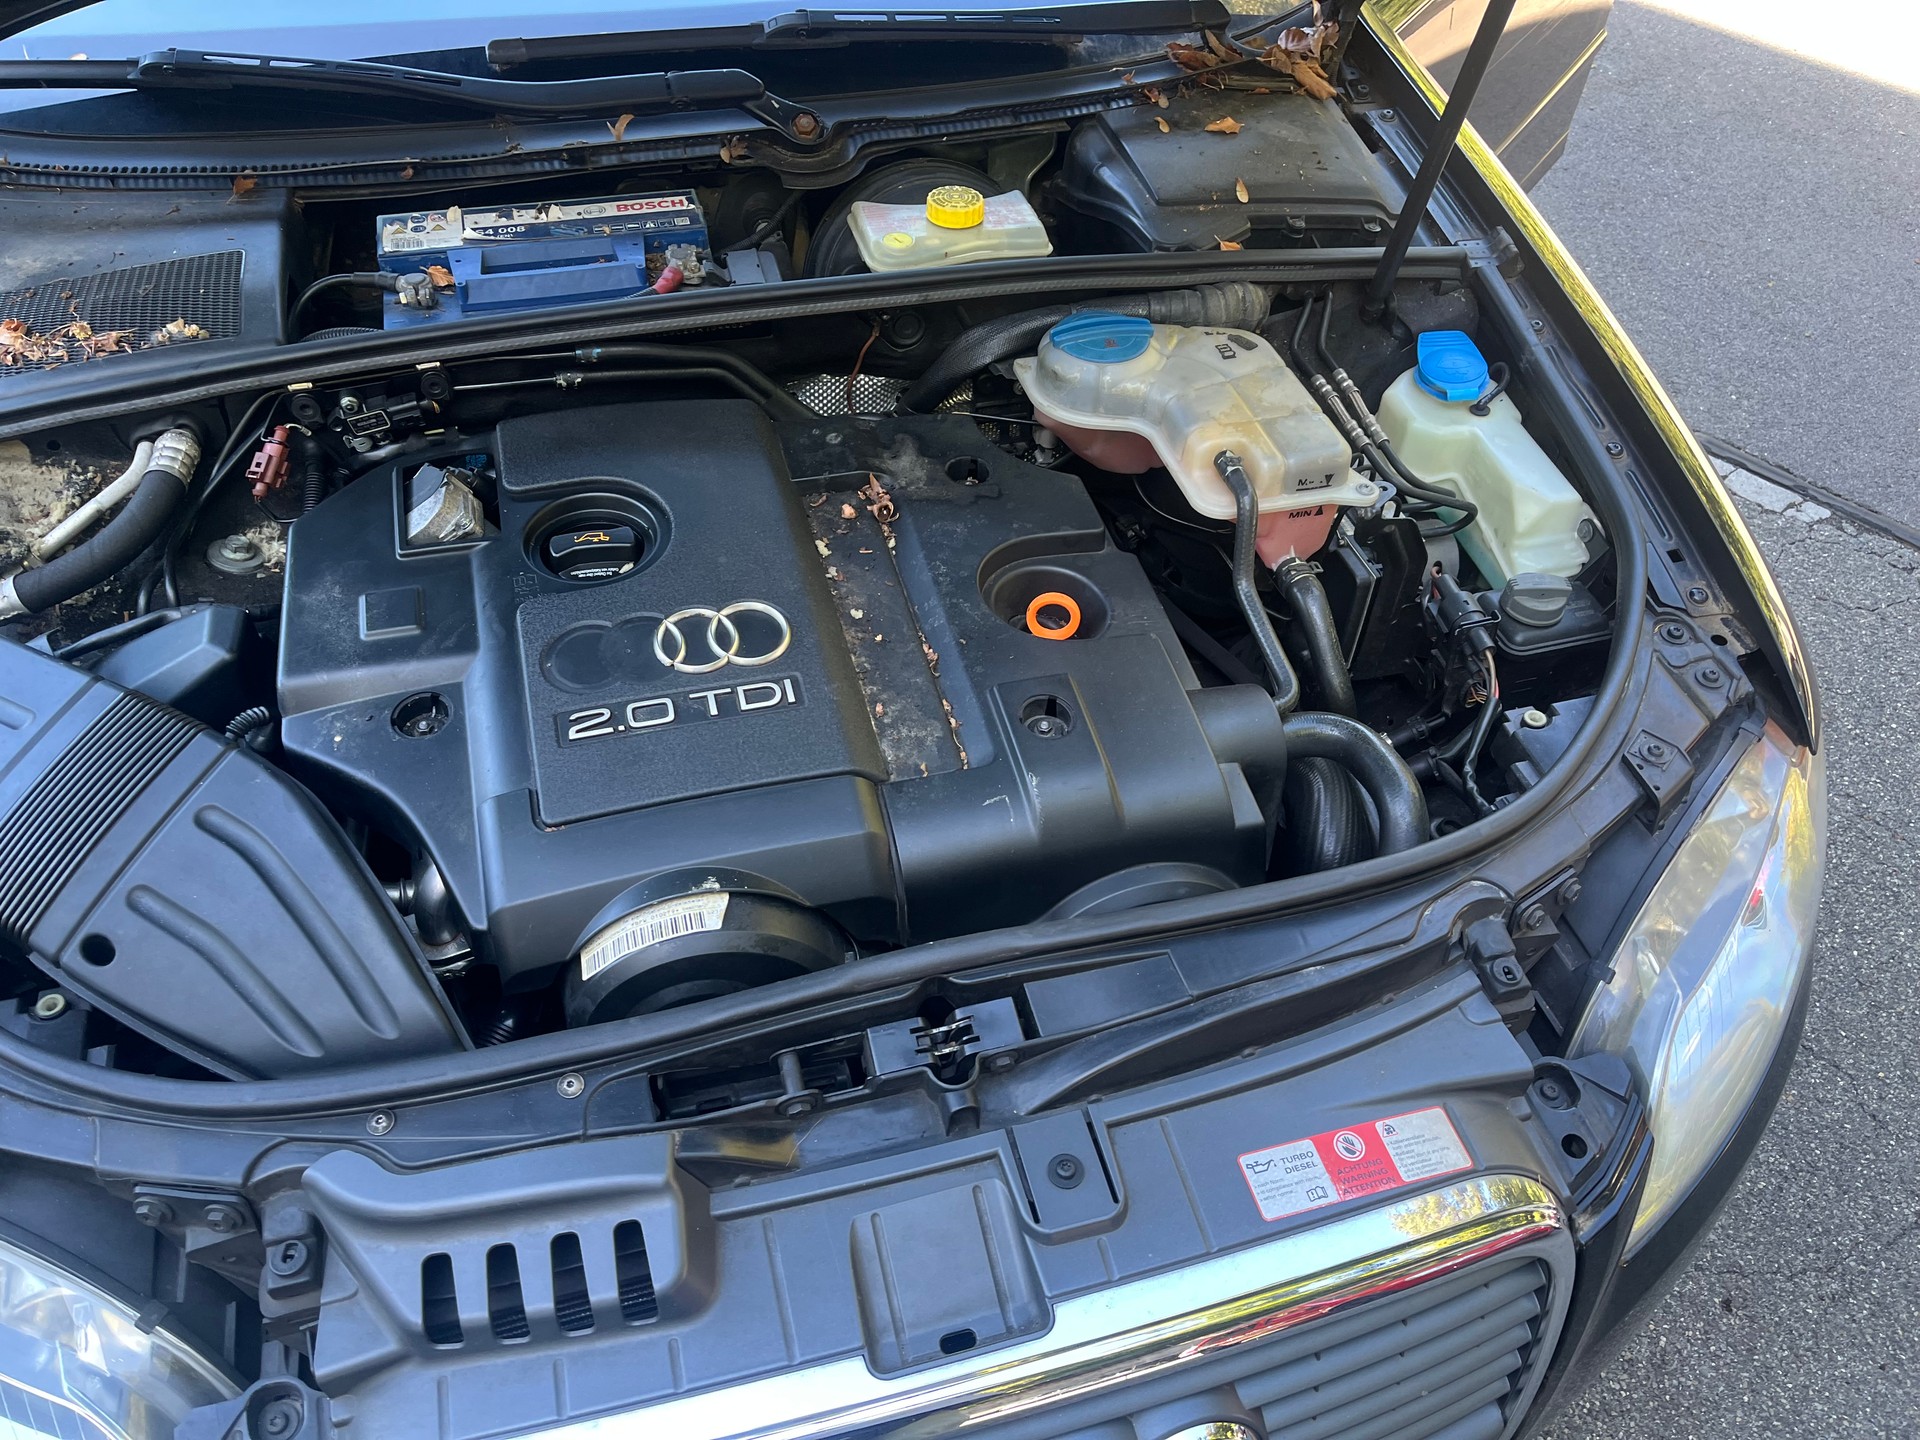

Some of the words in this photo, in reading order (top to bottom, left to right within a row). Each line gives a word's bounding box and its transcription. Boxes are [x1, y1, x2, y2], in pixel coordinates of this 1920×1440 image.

[615, 197, 685, 214] BOSCH
[498, 225, 526, 234] 008
[1288, 509, 1313, 520] MIN
[568, 697, 675, 741] 2.0
[689, 678, 797, 717] TDI
[1279, 1150, 1314, 1165] TURBO
[1284, 1161, 1319, 1174] DIESEL
[1337, 1158, 1384, 1176] ACHTUNG
[1341, 1167, 1389, 1185] WARNING
[1343, 1176, 1397, 1196] ATTENTION
